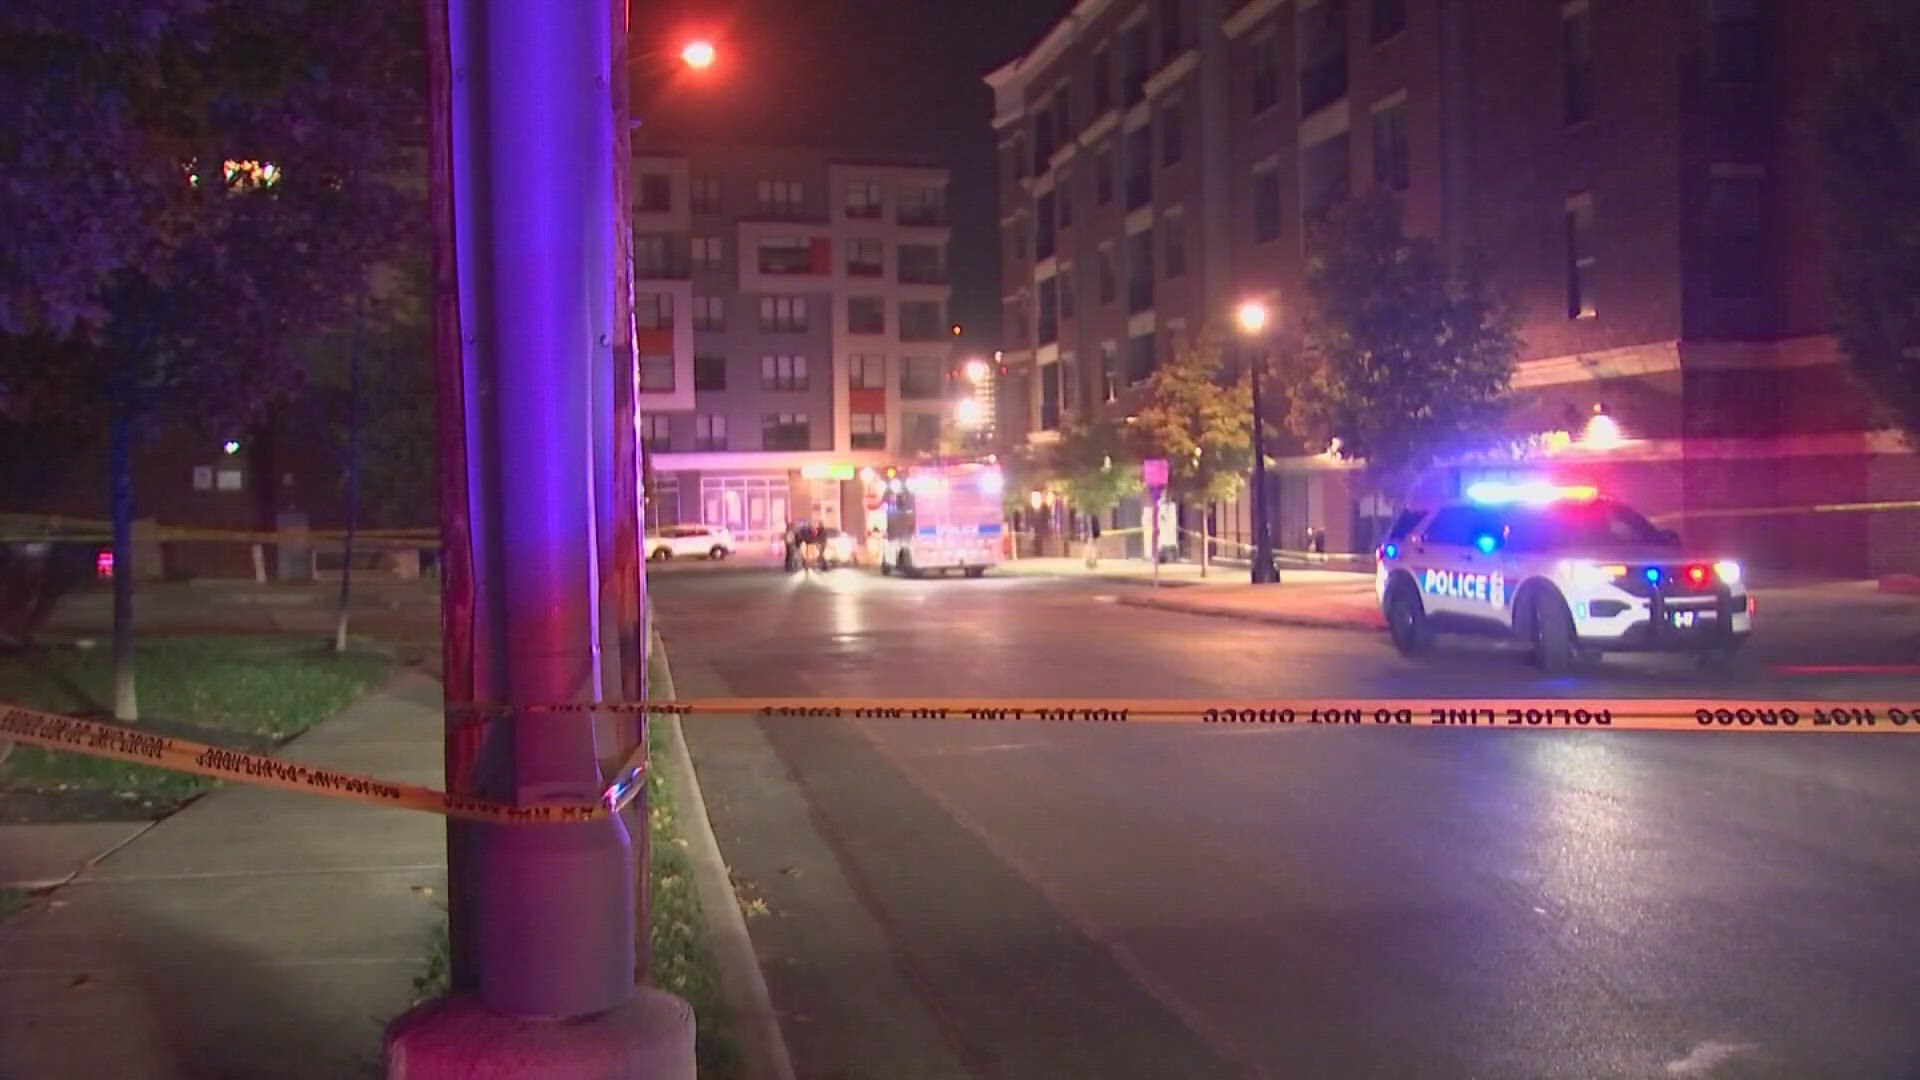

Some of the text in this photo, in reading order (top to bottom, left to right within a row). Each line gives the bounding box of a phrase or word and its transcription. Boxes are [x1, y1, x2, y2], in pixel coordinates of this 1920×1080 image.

[1425, 568, 1488, 600] POLICE
[1374, 709, 1412, 724] DO
[1431, 709, 1495, 725] LINE
[1507, 709, 1612, 725] POLICE
